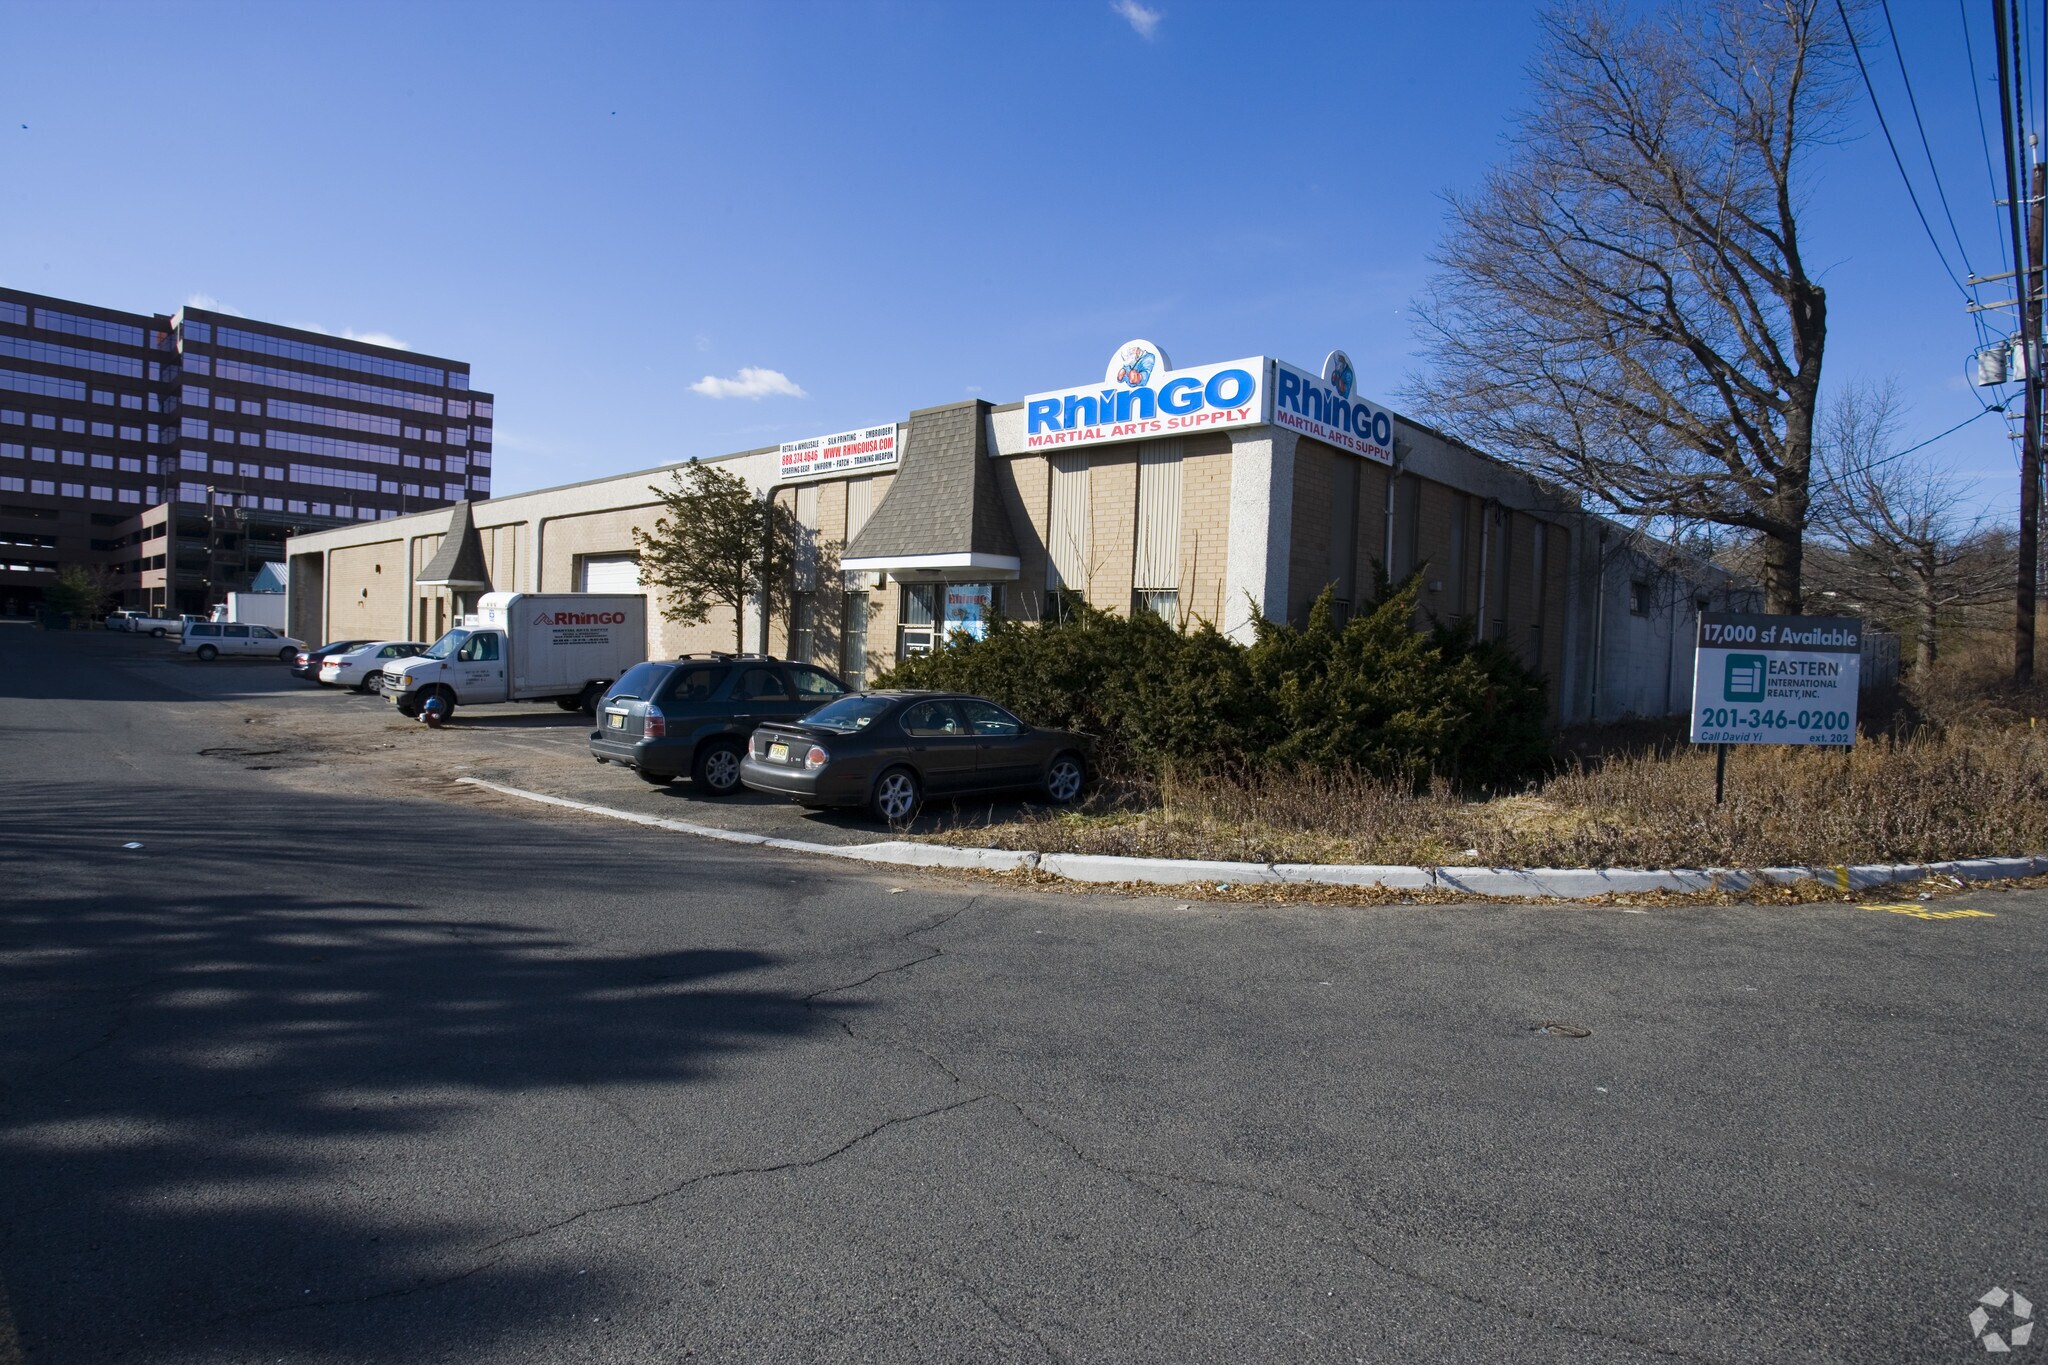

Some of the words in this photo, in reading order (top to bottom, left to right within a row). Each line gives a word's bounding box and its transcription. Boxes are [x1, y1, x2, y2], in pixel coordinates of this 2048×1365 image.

[1028, 427, 1106, 448] MARTIAL
[1111, 419, 1161, 437] ARTS
[1167, 407, 1252, 430] SUPPLY
[1278, 410, 1327, 438] MARTIAL
[1328, 429, 1355, 449] ARTS
[1356, 440, 1391, 461] SUPPLY
[782, 444, 794, 453] RETAIL
[798, 440, 819, 451] WHOLESALE
[828, 437, 837, 446] SILK
[837, 433, 857, 444] PRINTING
[865, 426, 894, 439] EMBROIDERY
[781, 466, 800, 476] SPARRING
[800, 464, 810, 473] GEAR
[814, 461, 832, 471] UNIFORM
[836, 458, 850, 468] PATCH
[854, 455, 875, 465] TRAINING
[875, 451, 894, 461] WEAPON
[554, 612, 626, 625] RhinGO
[1703, 624, 1757, 644] 17,000
[1761, 625, 1777, 643] sf
[1780, 627, 1858, 647] Available
[1768, 660, 1839, 677] EASTERN
[1767, 678, 1837, 688] INTERNATIONAL
[1701, 707, 1850, 731] 201-346-0200
[1701, 731, 1720, 741] Call
[1722, 732, 1750, 742] David
[1753, 733, 1763, 742] Yi
[1809, 735, 1828, 743] ext.
[1830, 733, 1849, 743] 202
